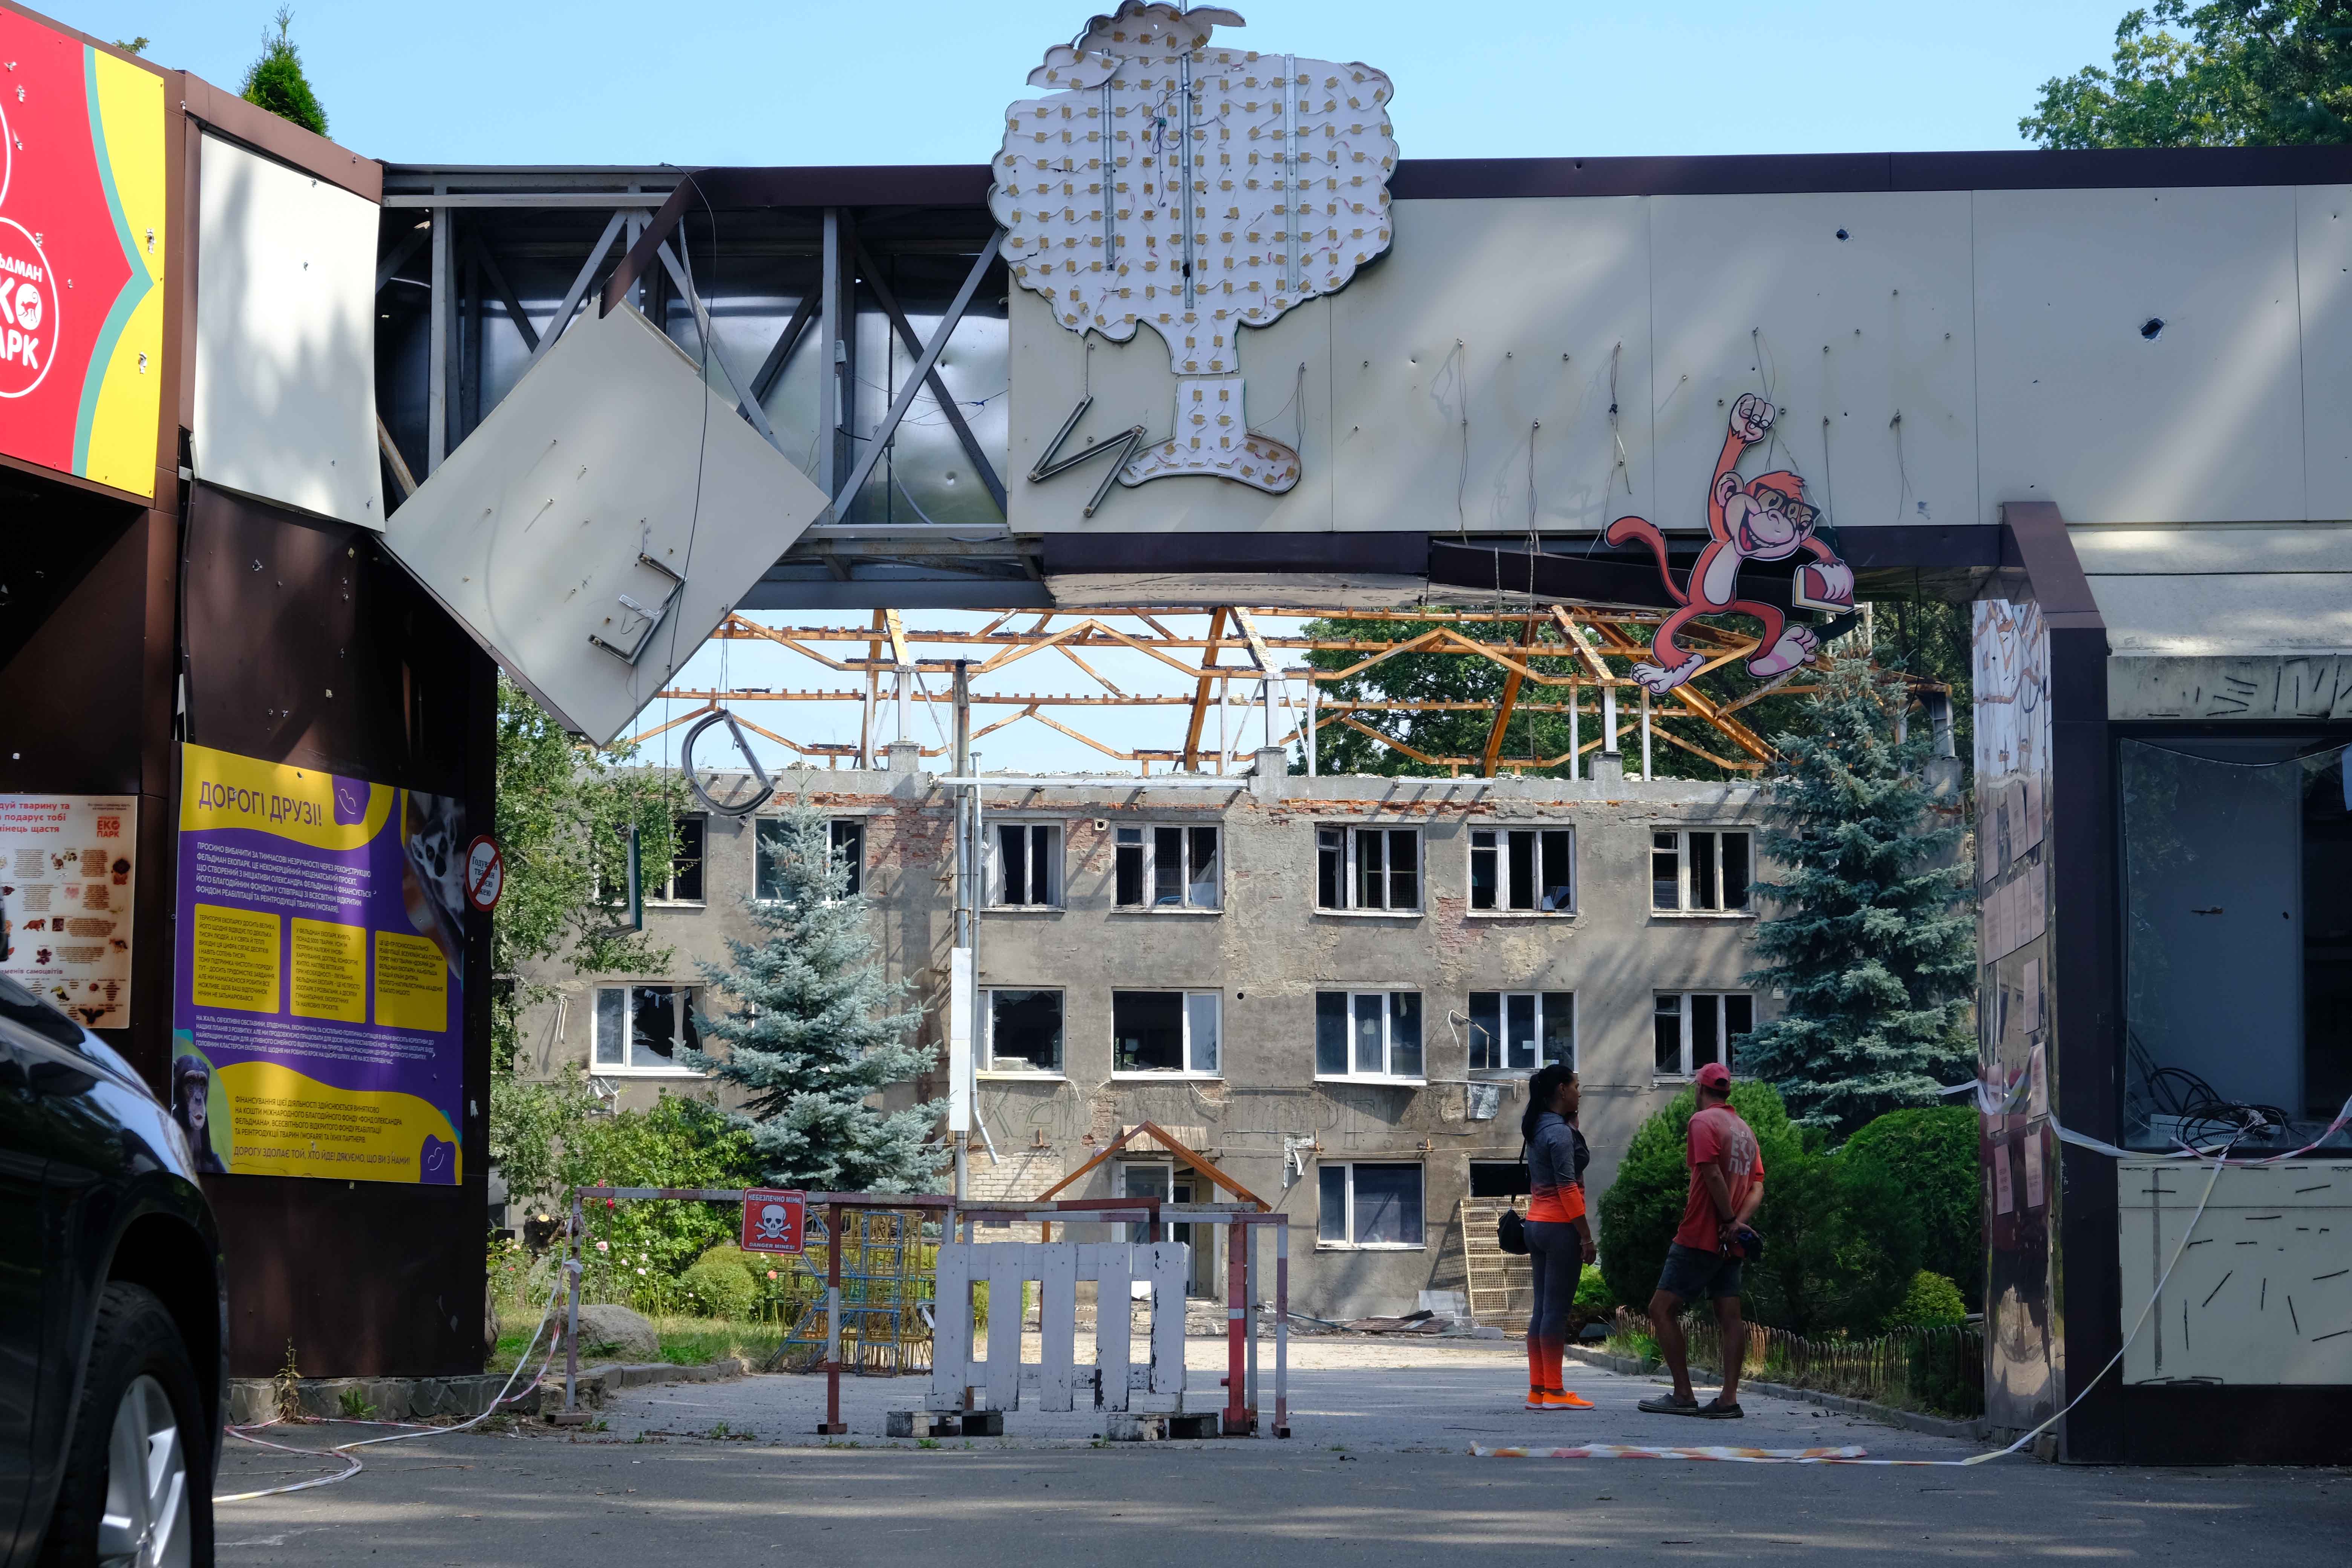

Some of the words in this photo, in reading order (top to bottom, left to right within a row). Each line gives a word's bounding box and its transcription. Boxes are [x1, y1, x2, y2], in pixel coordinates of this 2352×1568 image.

[199, 781, 265, 816] ДОРОГІ
[270, 795, 322, 827] ДРУЗІ!
[197, 842, 224, 853] ПРОСИМО
[225, 847, 251, 858] ВИБАЧИТИ
[259, 852, 286, 863] ТИМЧАСОВІ
[288, 857, 319, 869] НЕЗРУЧНОСТІ
[320, 863, 333, 871] ЧЕРЕЗ
[334, 865, 371, 877] РЕКОНСТРУКЦІЮ
[197, 853, 226, 864] ФЕЛЬДМАН
[227, 858, 251, 868] ЕКОПАРК.
[252, 862, 258, 870] ЦЕ
[260, 863, 300, 876] НЕКОМЕРЦІЙНИЙ
[302, 870, 338, 882] МЕЦЕНАТСЬКИЙ
[196, 873, 211, 883] ЙОГО
[212, 876, 249, 889] БЛАГОДІЙНИМ
[250, 882, 273, 893] ФОНДОМ
[278, 887, 303, 898] СПІВПРАЦІ
[309, 892, 336, 902] ВСЕСВІТНІМ
[337, 896, 361, 906] ВІДКРИТИМ
[197, 863, 206, 872] ЩО
[207, 865, 238, 876] СТВОРЕНИЙ
[243, 871, 270, 882] ІНІЦІАТИВИ
[271, 875, 302, 887] ОЛЕКСАНДРА
[304, 880, 332, 892] ФЕЛЬДМАНА
[338, 886, 371, 898] ФІНАНСУЄТЬСЯ
[476, 878, 493, 888] сєю
[234, 1147, 261, 1156] ДОРОГУ
[263, 1148, 289, 1158] ЗДОЛАЄ
[308, 1151, 320, 1160] ХТО
[368, 1155, 376, 1164] ЩО
[378, 1155, 385, 1164] ВИ
[748, 1194, 784, 1202] НЕБЕЗПЕЧНО
